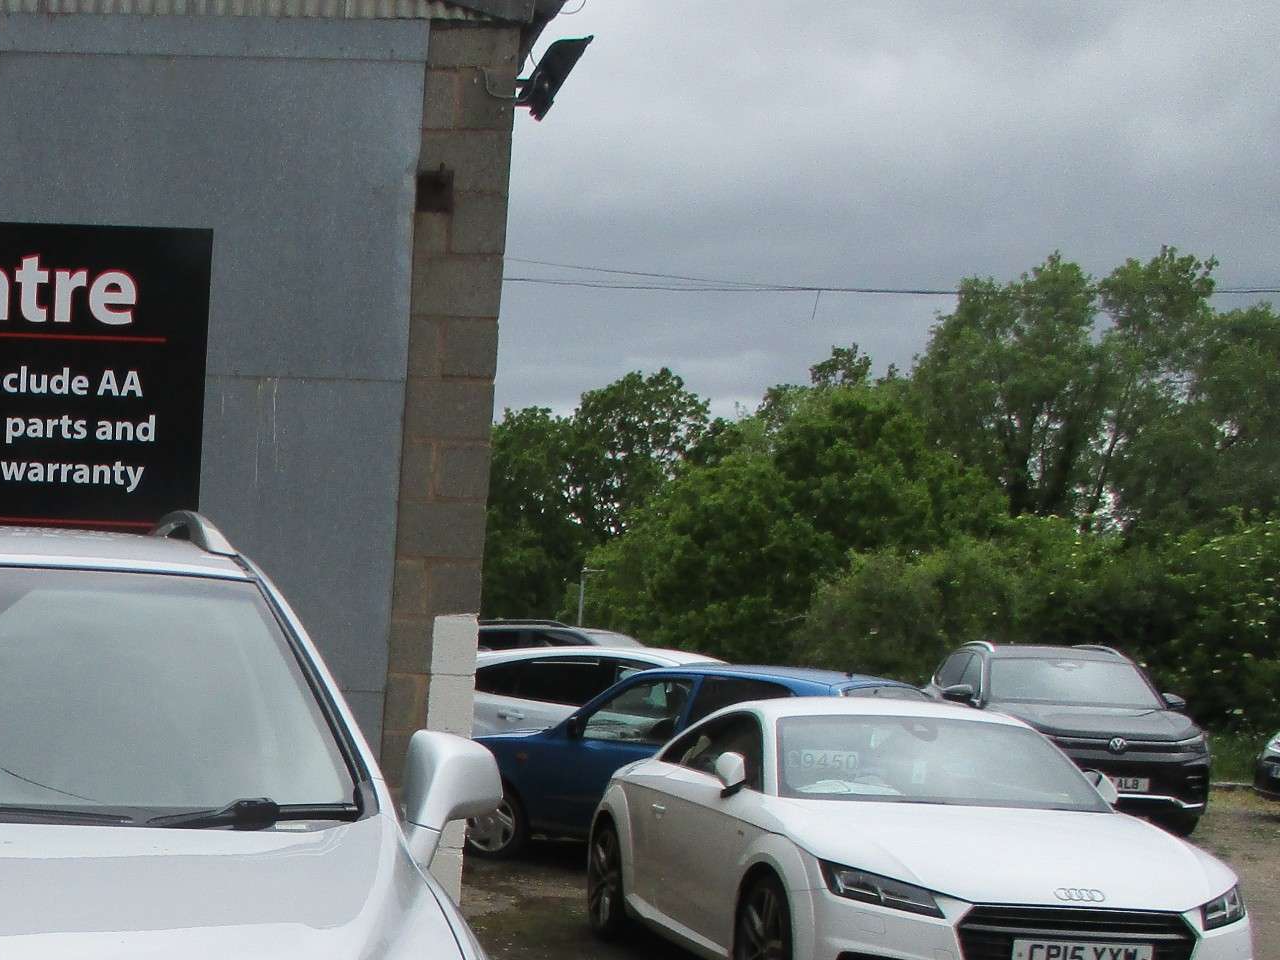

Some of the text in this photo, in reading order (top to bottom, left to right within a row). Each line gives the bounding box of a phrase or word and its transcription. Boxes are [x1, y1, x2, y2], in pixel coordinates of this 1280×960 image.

[97, 370, 142, 397] AA
[6, 415, 87, 443] parts
[96, 415, 155, 441] and
[1, 461, 144, 492] warranty
